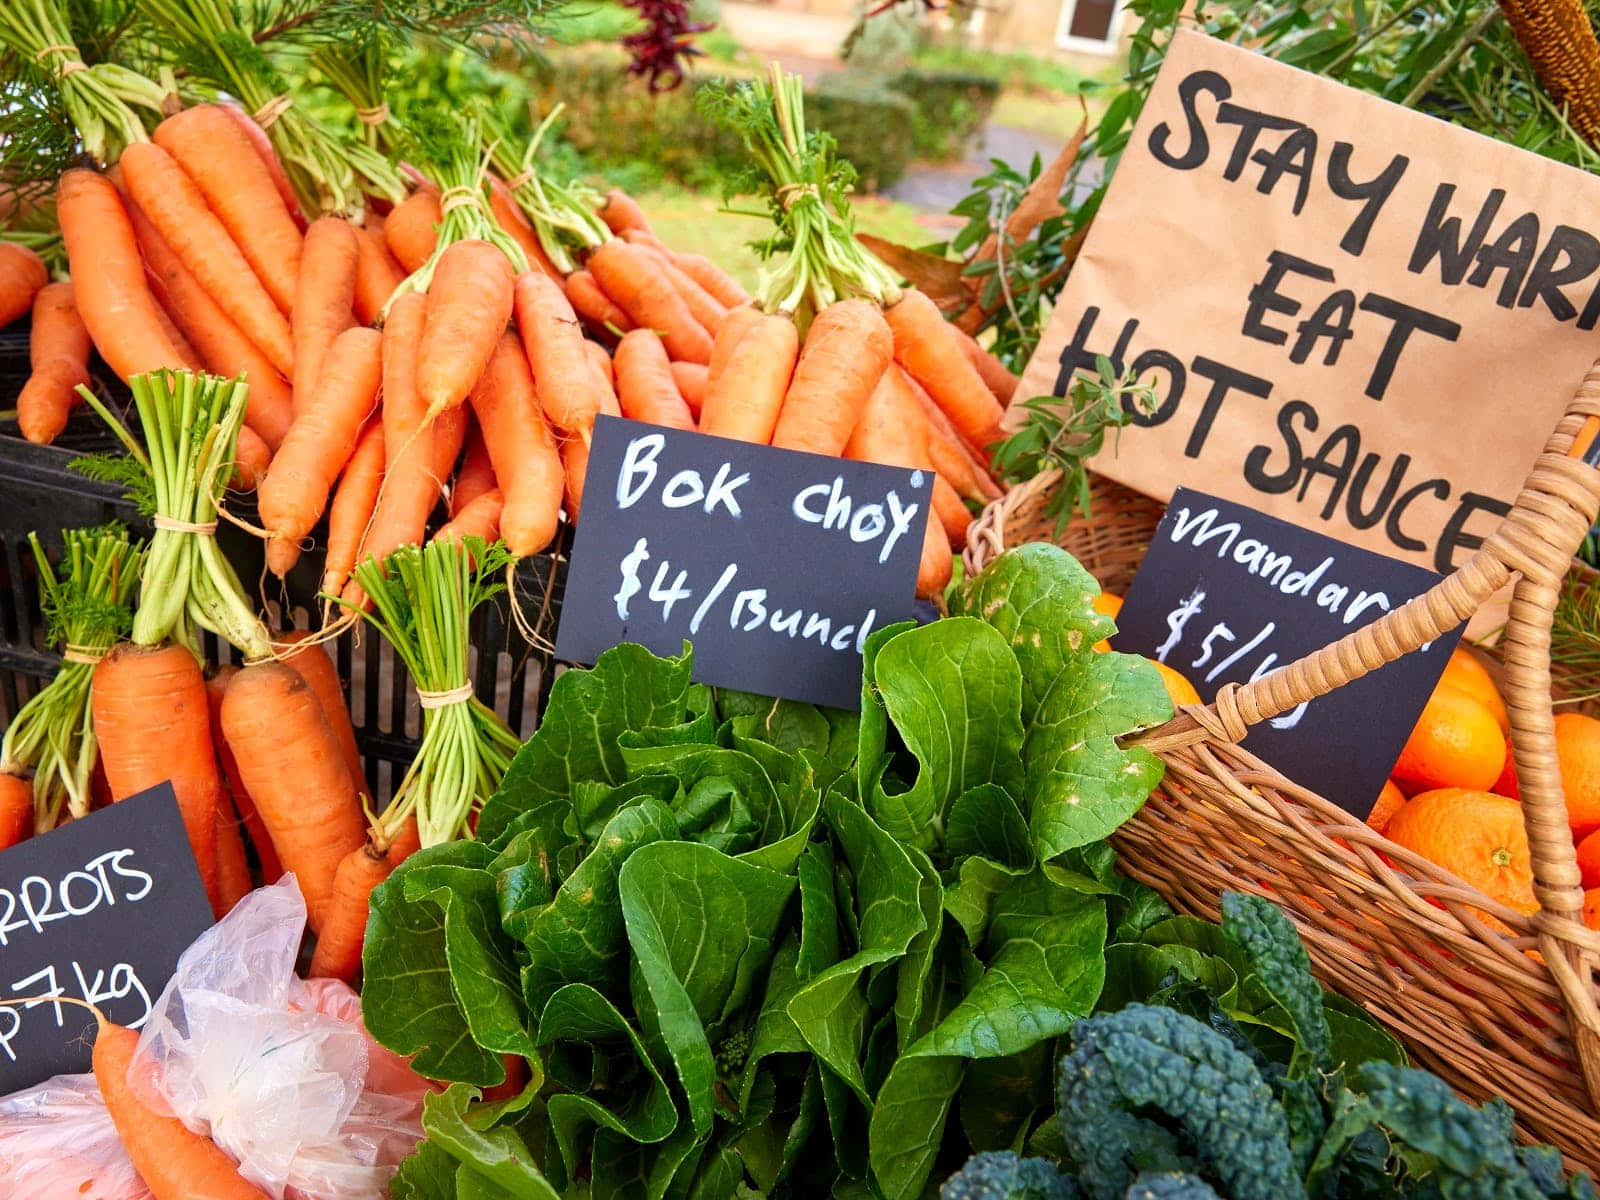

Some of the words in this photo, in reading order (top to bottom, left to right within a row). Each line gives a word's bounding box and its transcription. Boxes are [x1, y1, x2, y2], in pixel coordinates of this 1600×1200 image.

[1147, 70, 1410, 257] STAY
[1241, 249, 1462, 401] EAT
[1053, 305, 1274, 459] HOT
[1243, 400, 1515, 575] SAUCE
[1169, 506, 1432, 652] Mandar
